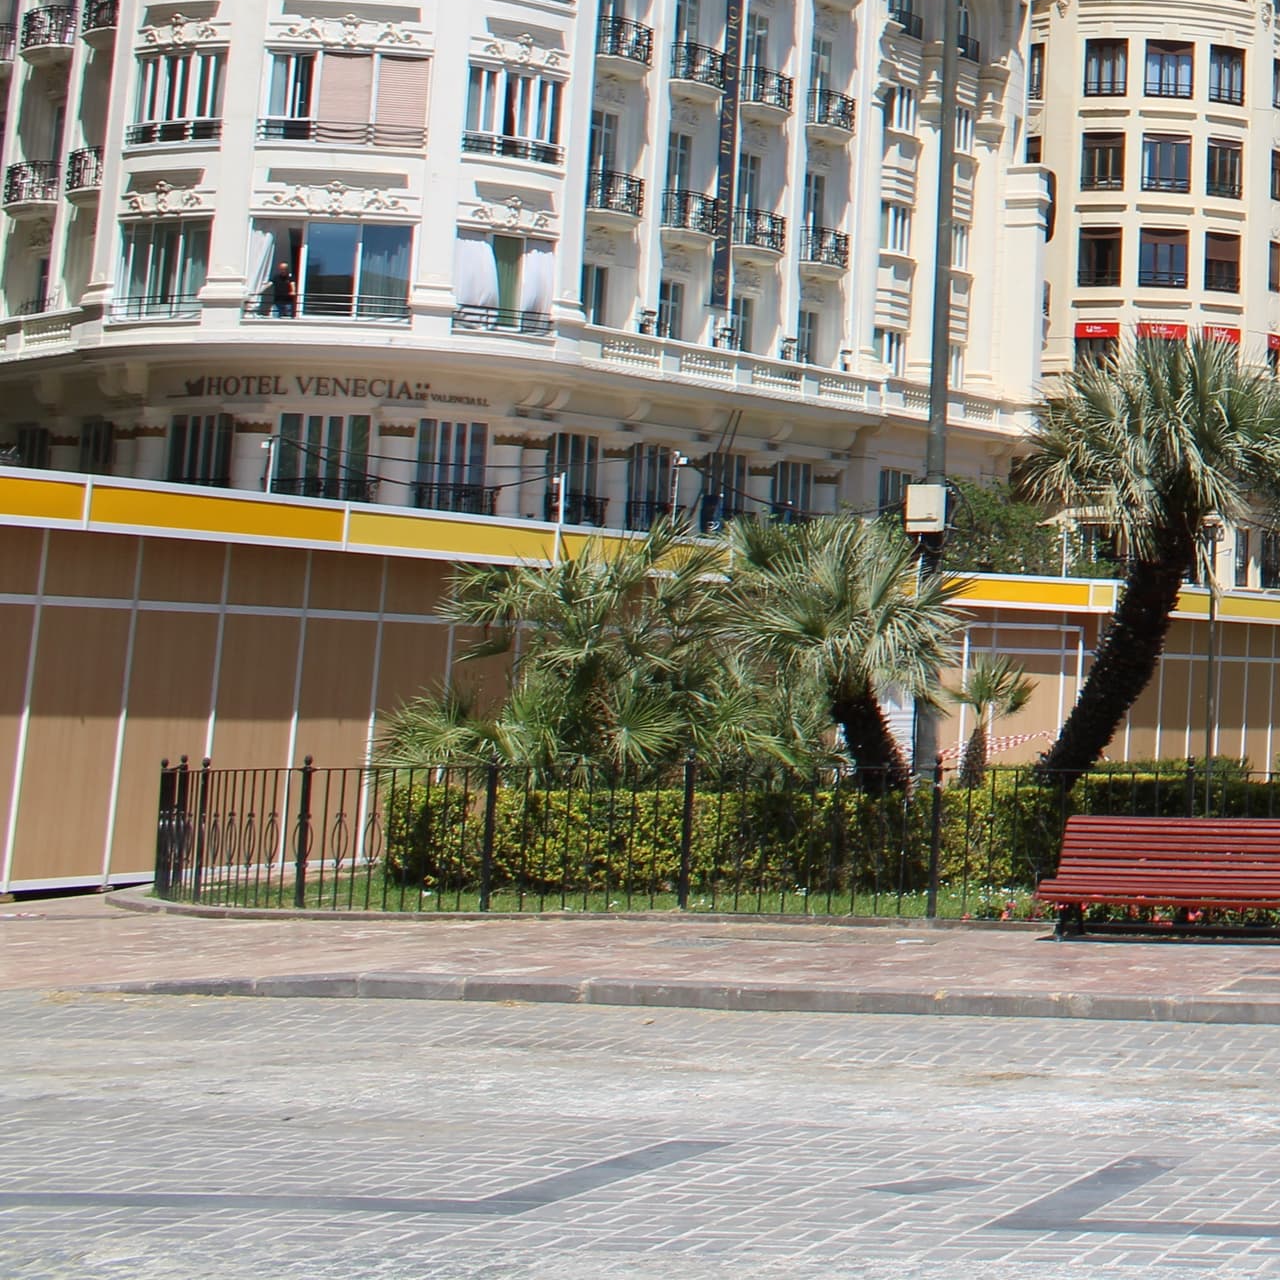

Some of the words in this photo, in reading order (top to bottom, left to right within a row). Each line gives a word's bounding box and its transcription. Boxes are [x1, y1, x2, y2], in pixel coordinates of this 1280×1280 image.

[725, 6, 741, 81] CENTRO
[720, 97, 734, 155] PLAZA
[206, 375, 288, 396] HOTEL
[295, 376, 414, 400] VENECIA
